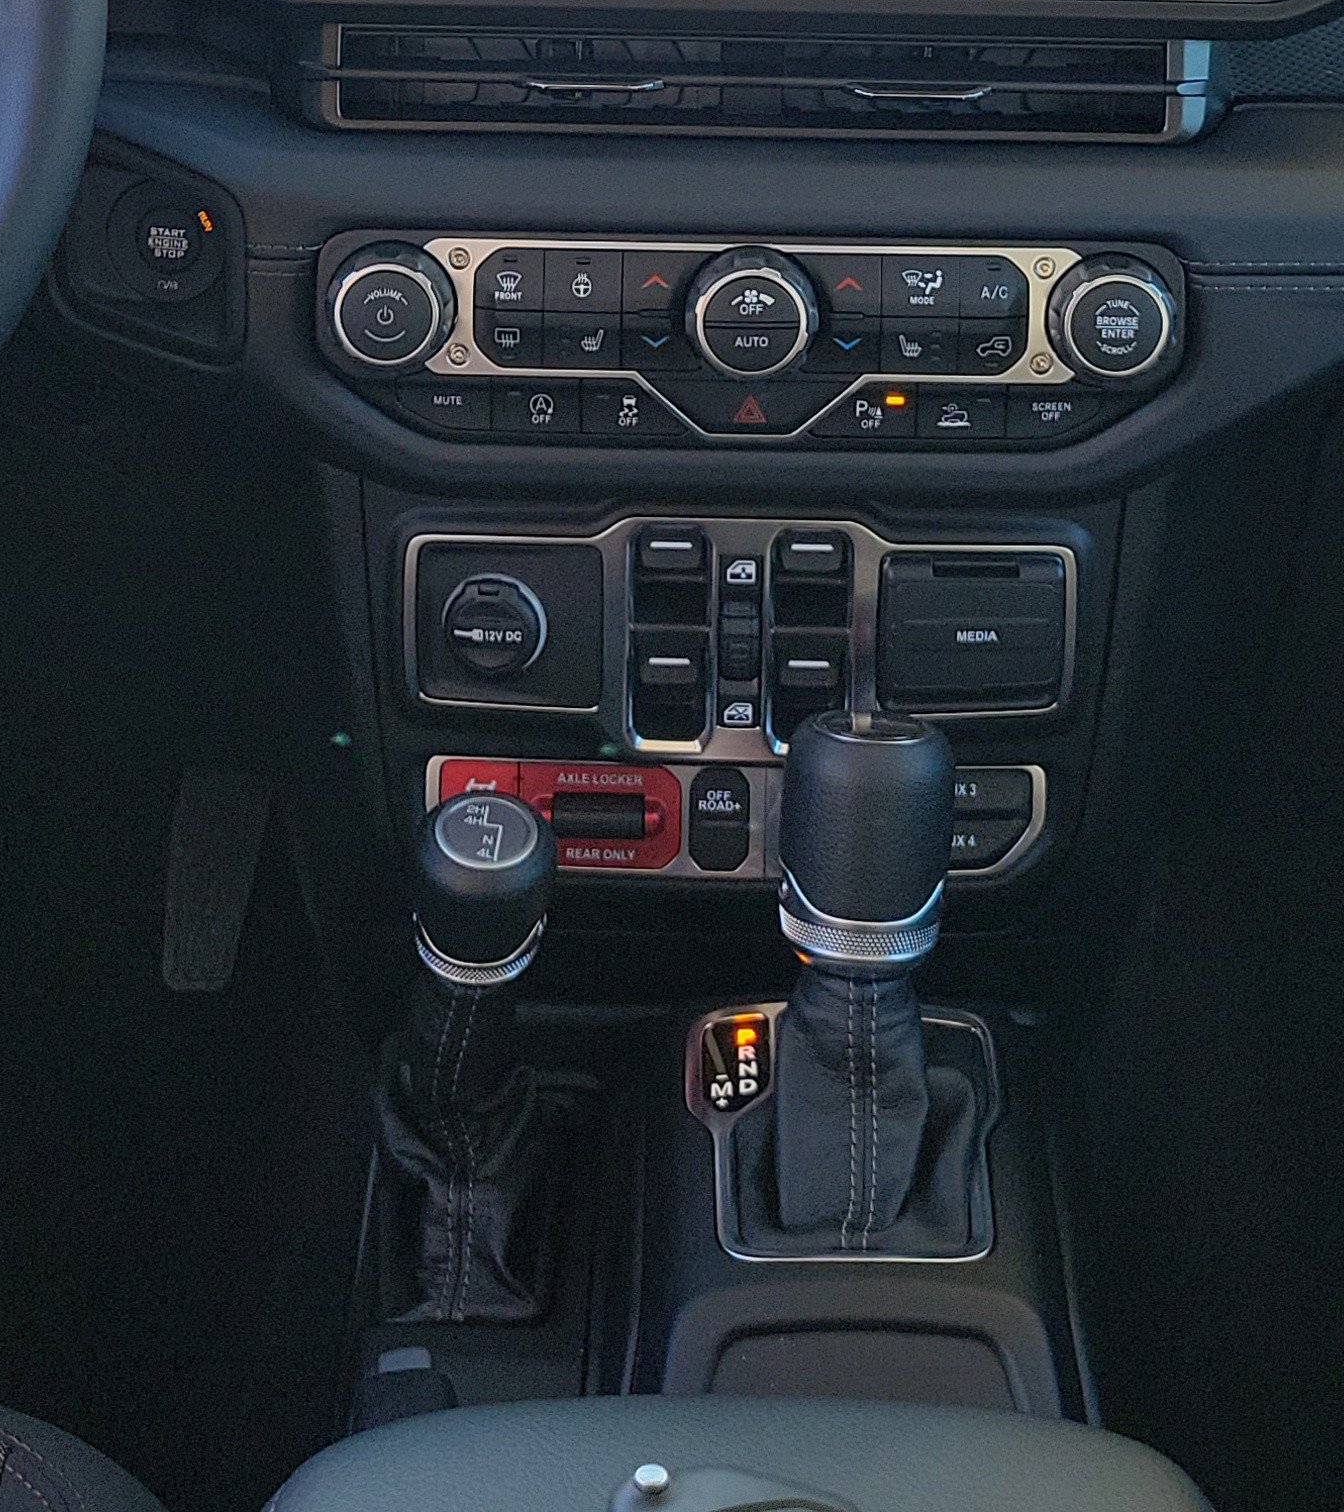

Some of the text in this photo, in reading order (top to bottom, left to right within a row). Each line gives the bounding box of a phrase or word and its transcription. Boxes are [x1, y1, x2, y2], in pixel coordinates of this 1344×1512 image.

[150, 227, 186, 237] START
[148, 238, 188, 248] ENGINE
[154, 249, 185, 258] STOP
[981, 285, 1009, 301] A/C
[910, 295, 935, 306] MODE
[739, 303, 765, 315] OFF
[1096, 316, 1139, 327] BROWSE
[1101, 328, 1135, 340] ENTER
[734, 336, 769, 349] AUTO
[434, 395, 463, 406] MUTE
[1032, 402, 1072, 414] SCREEN
[530, 413, 552, 424] OFF
[618, 416, 639, 427] OFF
[861, 419, 881, 429] OFF
[956, 630, 998, 642] MEDIA
[557, 773, 643, 785] AXLE LOCKER
[706, 790, 732, 801] OFF
[699, 800, 742, 811] ROAD+
[566, 848, 636, 860] REAR ONLY
[737, 1029, 756, 1045] P
[738, 1045, 756, 1061] R
[738, 1061, 758, 1077] N
[739, 1079, 758, 1096] D
